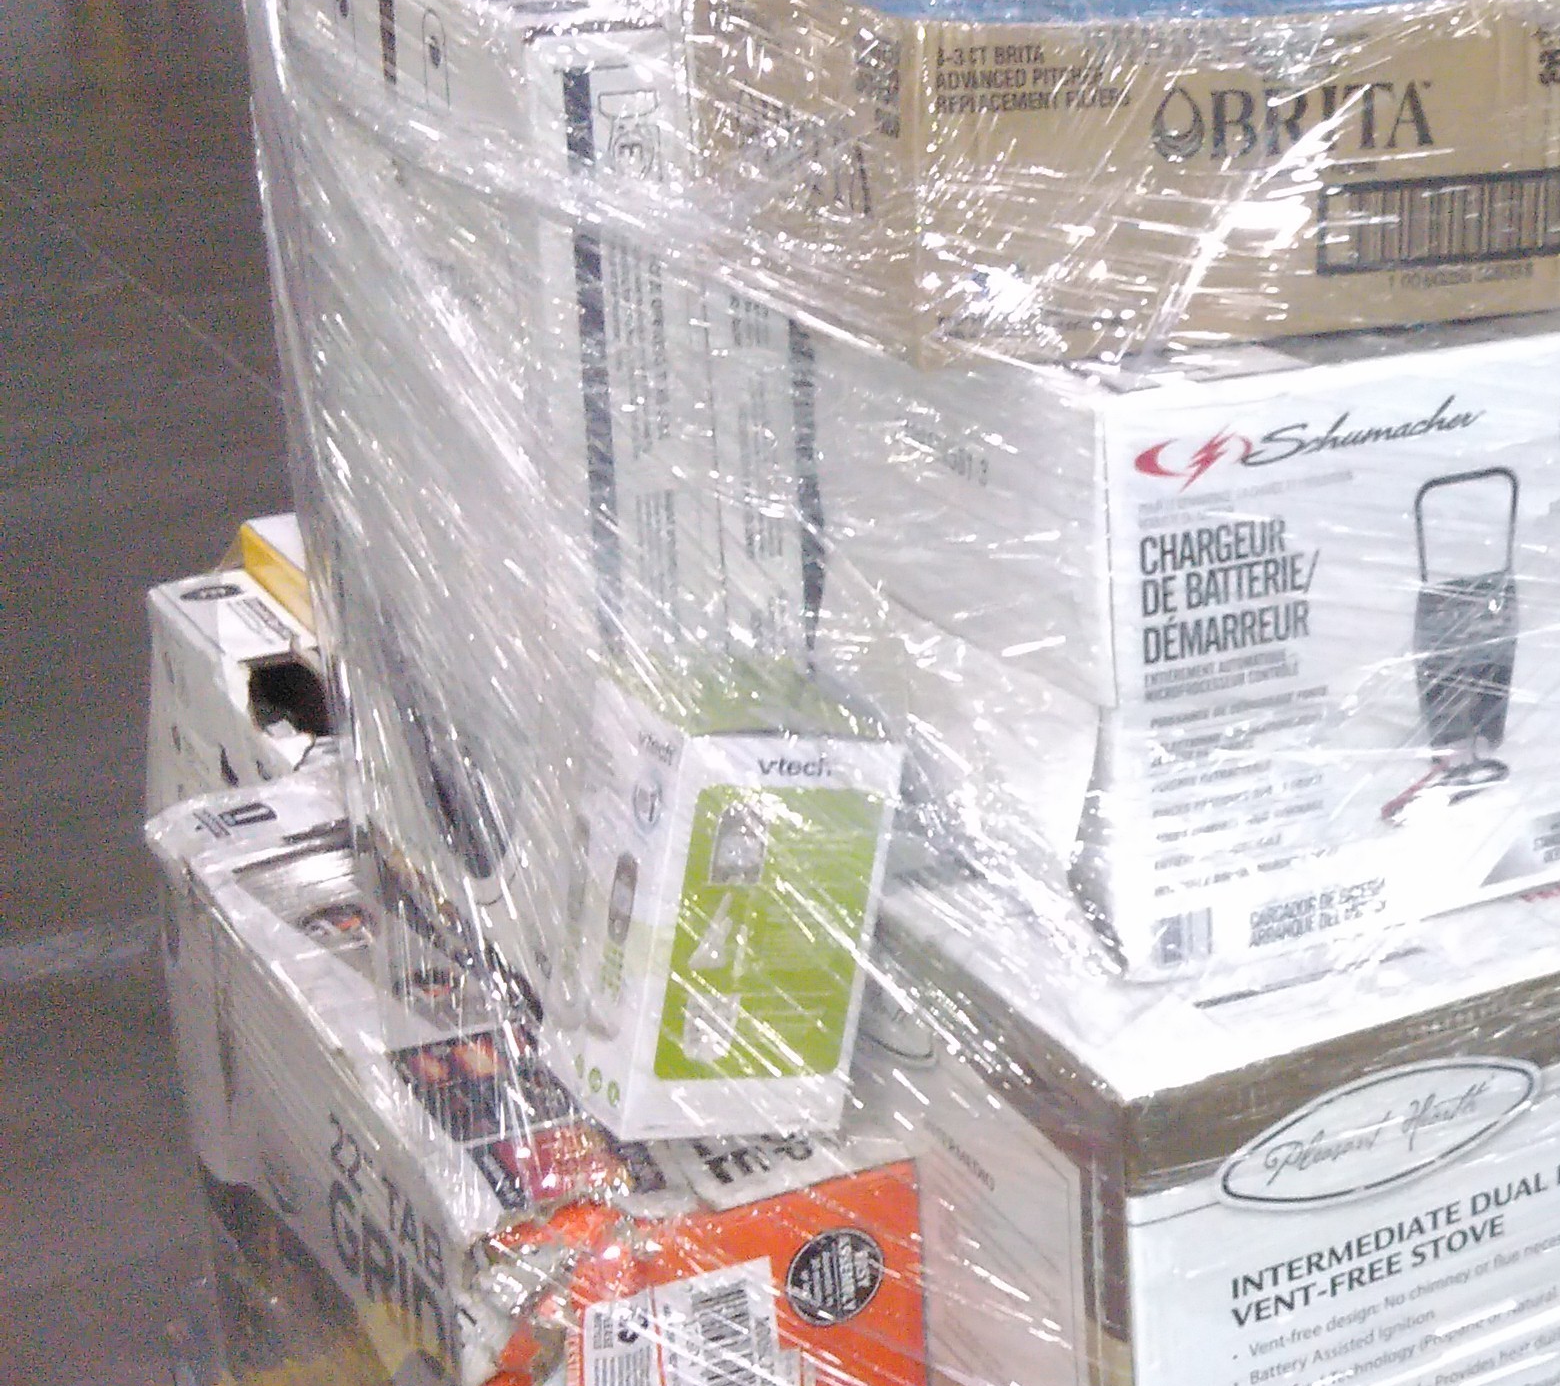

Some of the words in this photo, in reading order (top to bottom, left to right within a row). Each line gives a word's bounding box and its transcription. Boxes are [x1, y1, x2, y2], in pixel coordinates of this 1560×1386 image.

[1210, 77, 1435, 161] BRITA
[1242, 394, 1488, 466] Schumacher
[1139, 517, 1286, 576] CHARGEUR
[1141, 574, 1178, 618] DE
[1185, 548, 1321, 610] BATTERIE/
[1142, 601, 1310, 665] DÉMARREUR
[1231, 1201, 1461, 1300] INTERMEDIATE
[1471, 1173, 1548, 1215] DUAL
[1231, 1253, 1402, 1328] VENT-FREE
[1411, 1215, 1505, 1267] STOVE
[1248, 1322, 1321, 1357] Vent-free
[1384, 1291, 1405, 1310] No
[1408, 1268, 1469, 1302] chimney
[1474, 1261, 1489, 1276] or
[1493, 1249, 1519, 1268] flue
[1249, 1354, 1306, 1386] Battery
[1312, 1330, 1374, 1363] Assisted
[1378, 1309, 1434, 1340] Ignition
